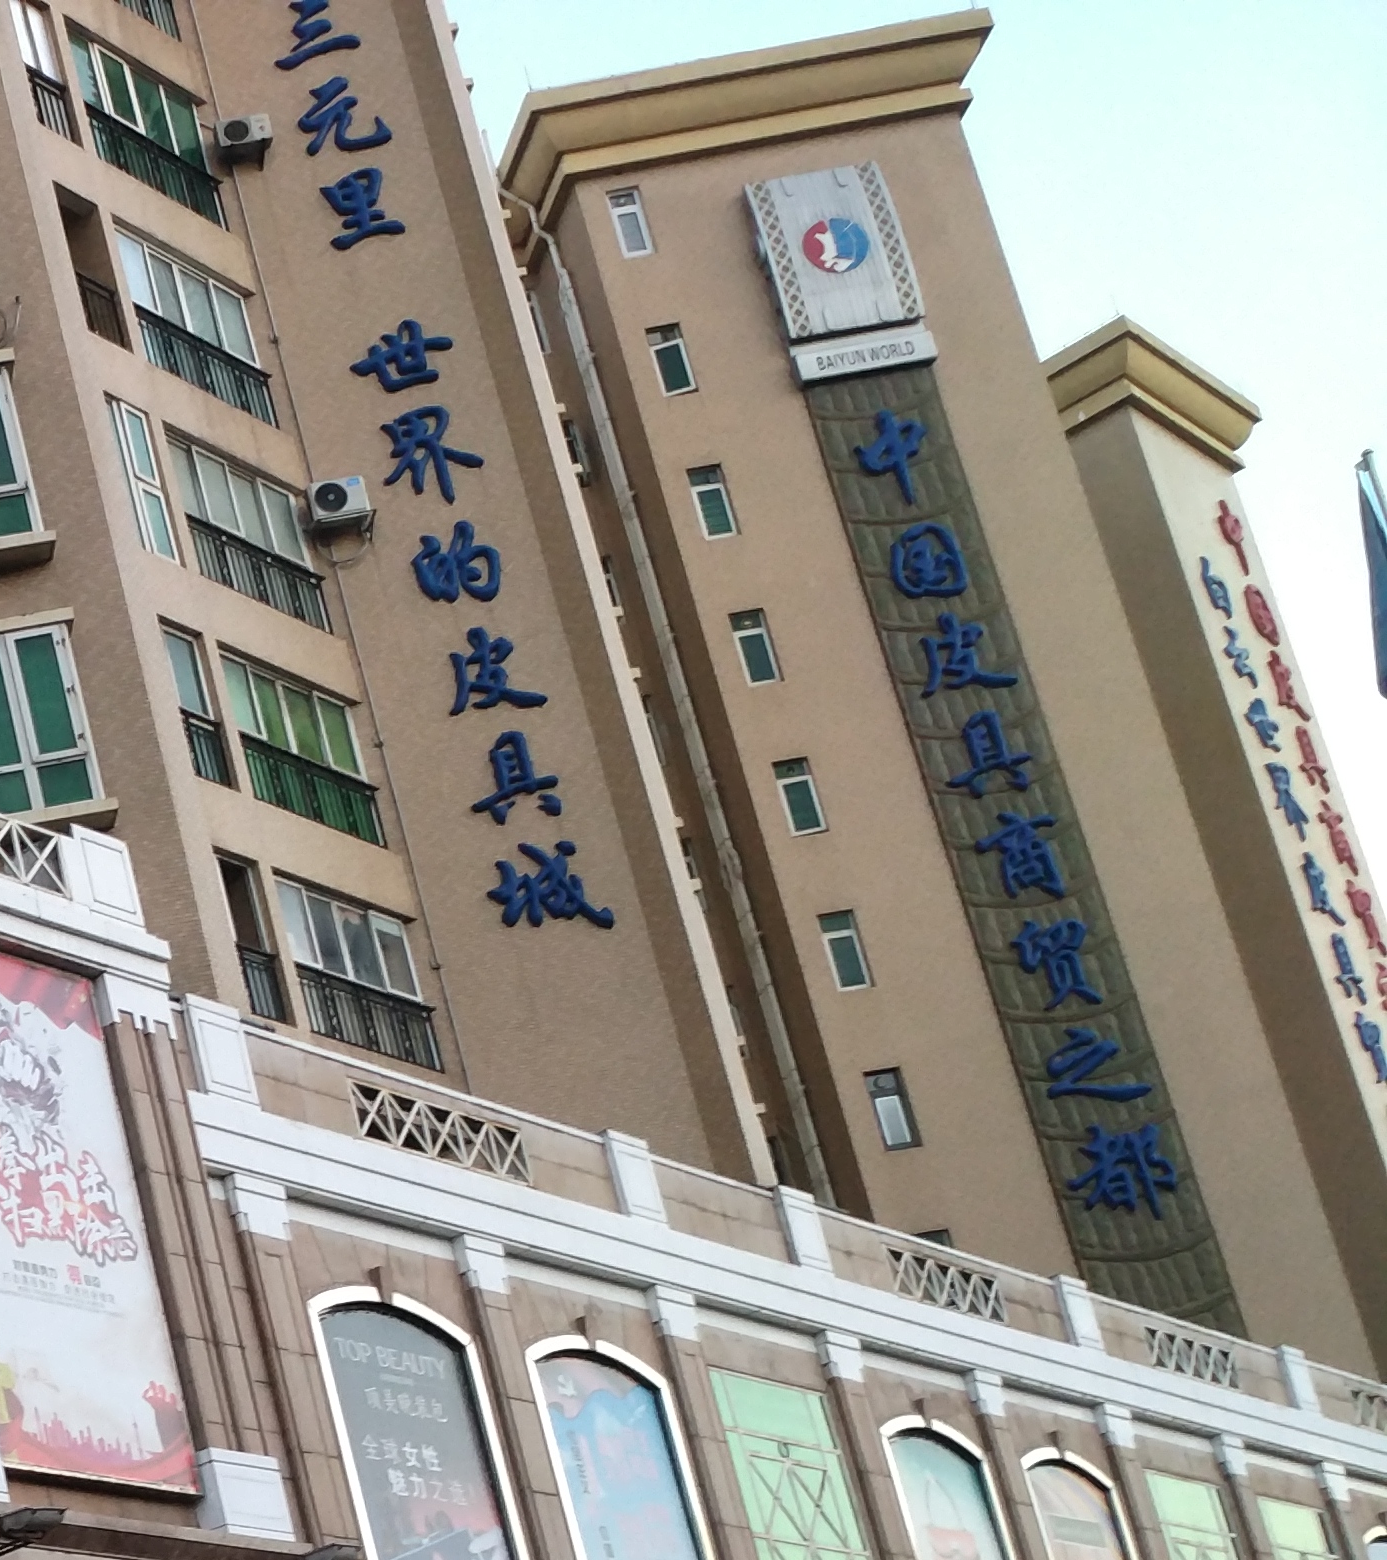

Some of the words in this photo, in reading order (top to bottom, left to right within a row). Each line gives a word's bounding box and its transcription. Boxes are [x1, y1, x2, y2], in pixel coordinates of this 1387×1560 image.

[815, 350, 867, 371] BAIYUN
[869, 341, 916, 362] WORLD
[349, 318, 615, 931] 世界的皮具城
[854, 408, 1177, 1221] 中国皮具商贸之都
[0, 1190, 137, 1264] 扫黑除恶
[333, 1337, 372, 1363] TOP
[375, 1345, 446, 1379] BEAUTY
[361, 1434, 443, 1472] 全球女性
